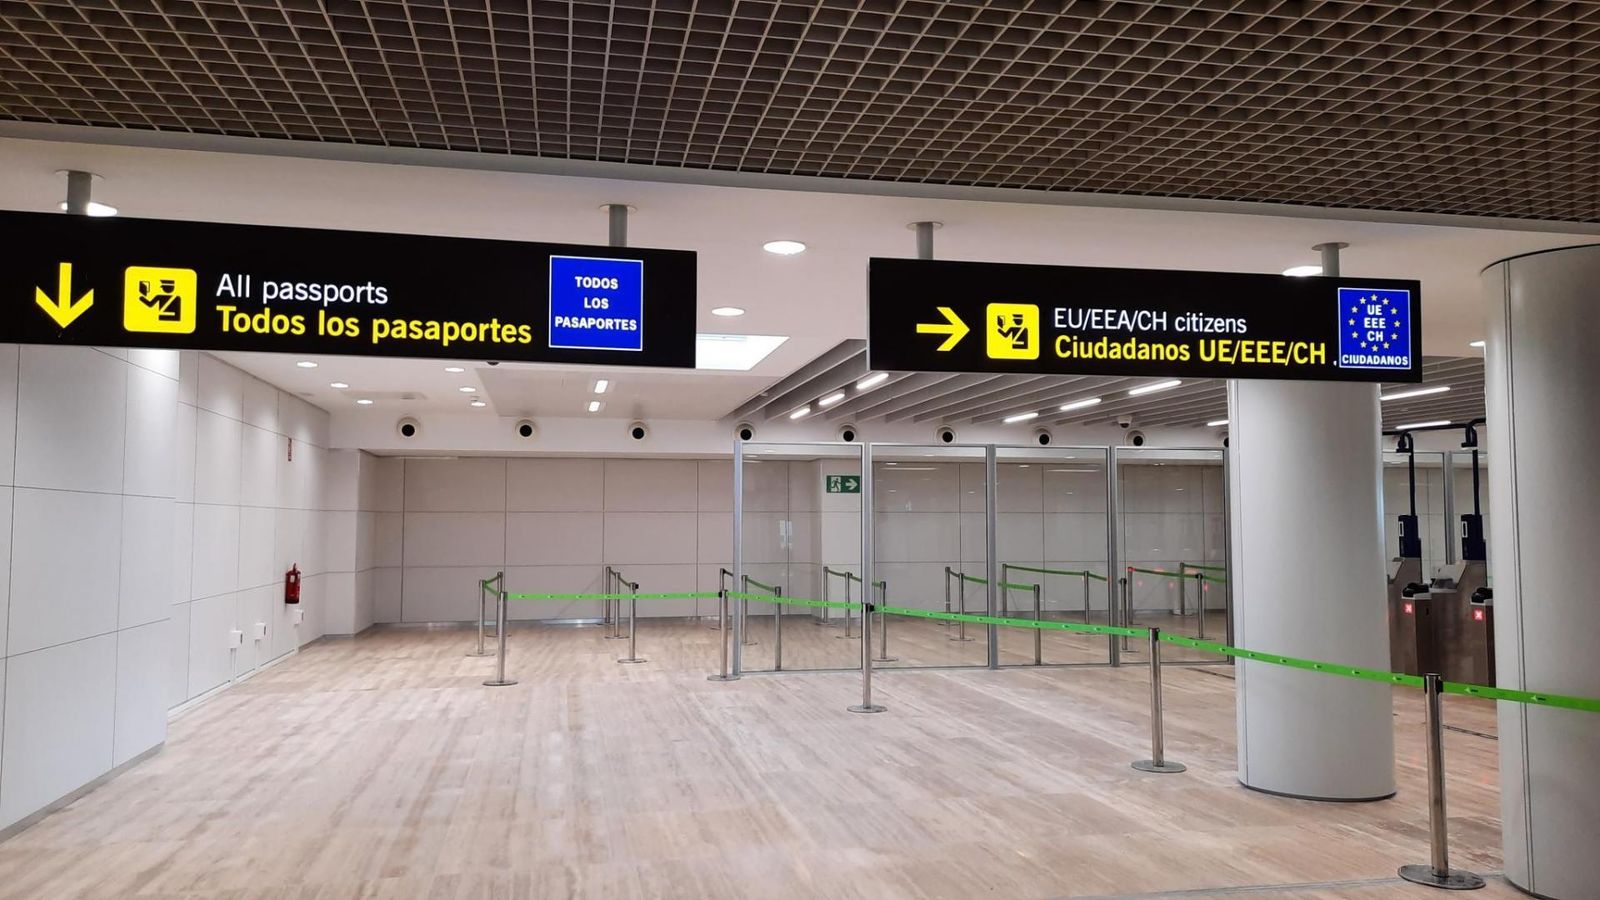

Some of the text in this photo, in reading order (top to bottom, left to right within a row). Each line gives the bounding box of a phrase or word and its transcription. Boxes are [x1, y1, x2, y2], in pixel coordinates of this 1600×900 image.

[216, 274, 388, 306] All passports
[574, 276, 618, 290] TODOS
[584, 297, 609, 310] LOS
[1367, 304, 1383, 316] UE
[216, 305, 531, 346] Todos los pasaportes
[555, 316, 637, 331] PASAPORTES
[1054, 308, 1246, 333] EU/EEA/CH citizens
[1364, 317, 1386, 329] EEE
[1367, 330, 1384, 342] CH
[1055, 335, 1325, 366] Ciudadanos UE/EEE/CH
[1342, 354, 1409, 366] CIUDADANOS
